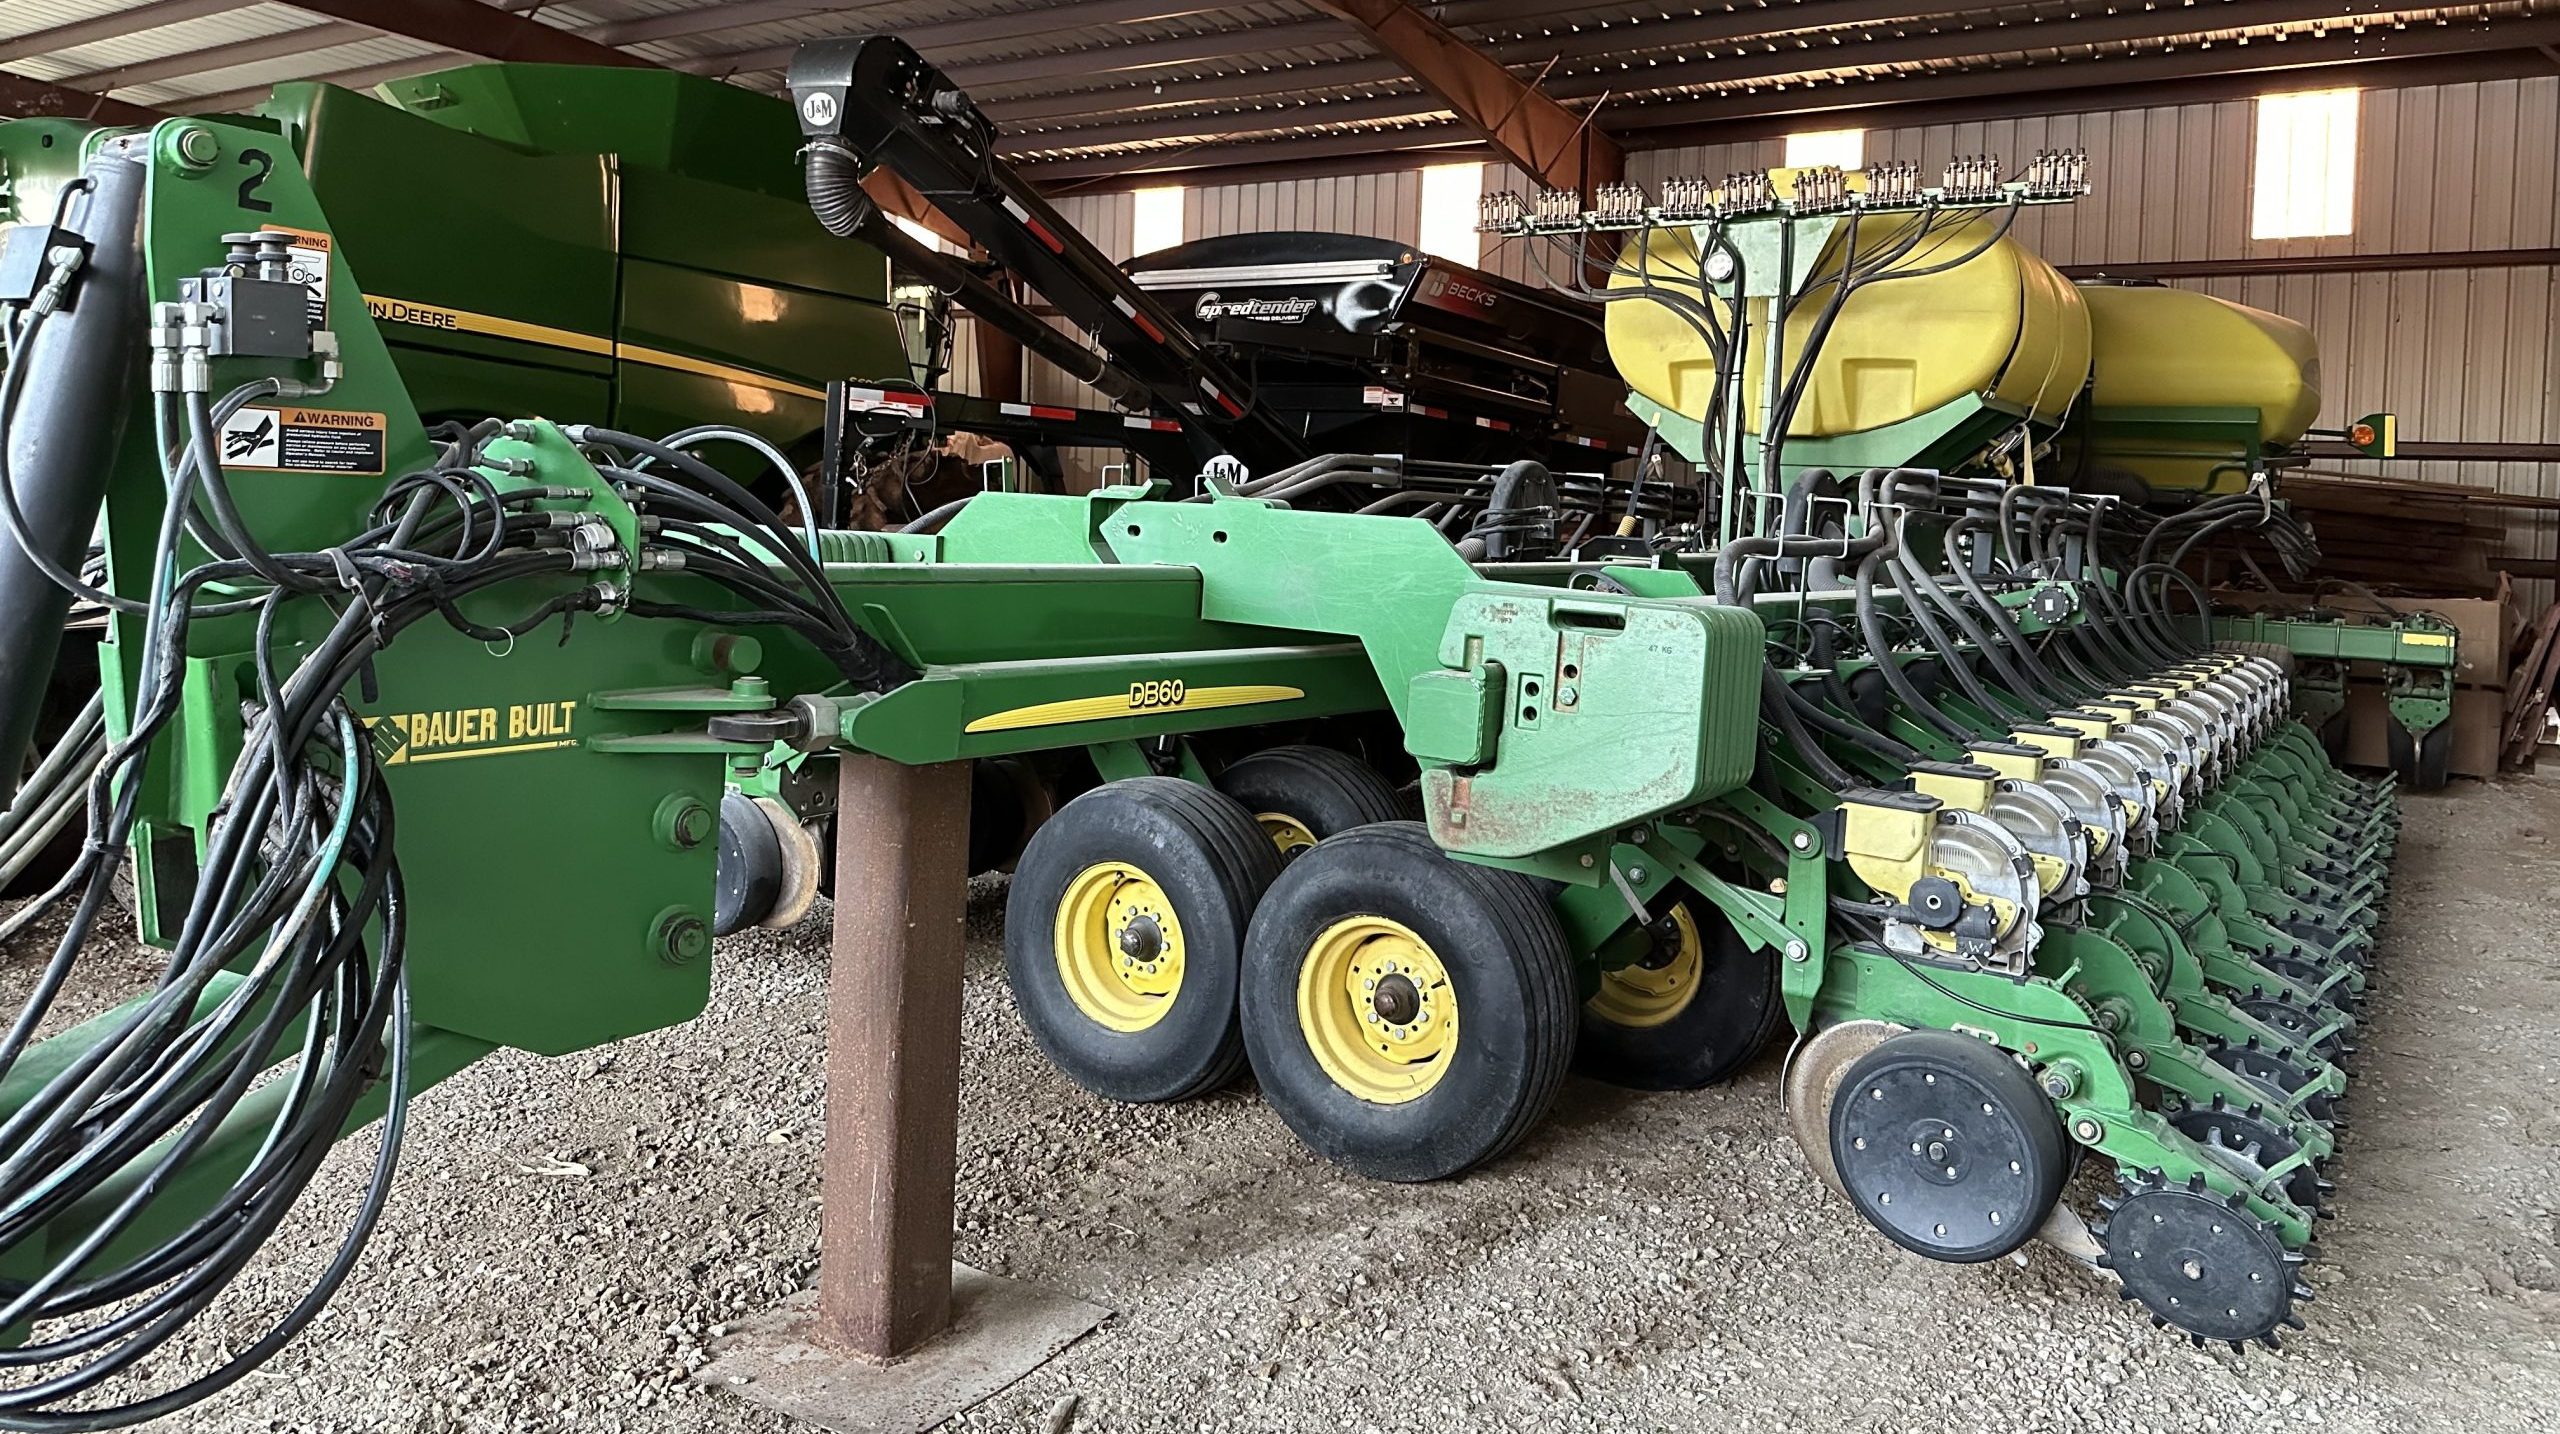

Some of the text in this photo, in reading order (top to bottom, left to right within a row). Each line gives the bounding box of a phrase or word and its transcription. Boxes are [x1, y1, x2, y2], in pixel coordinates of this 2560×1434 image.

[806, 98, 833, 119] J&M
[238, 148, 273, 213] 2
[295, 236, 328, 249] RNING
[1447, 282, 1497, 307] BECK'S
[392, 302, 457, 328] DEERE
[306, 412, 374, 427] WARNING
[1648, 644, 1659, 652] 47
[1129, 678, 1184, 708] DB60
[411, 701, 577, 748] BAUER BUILT
